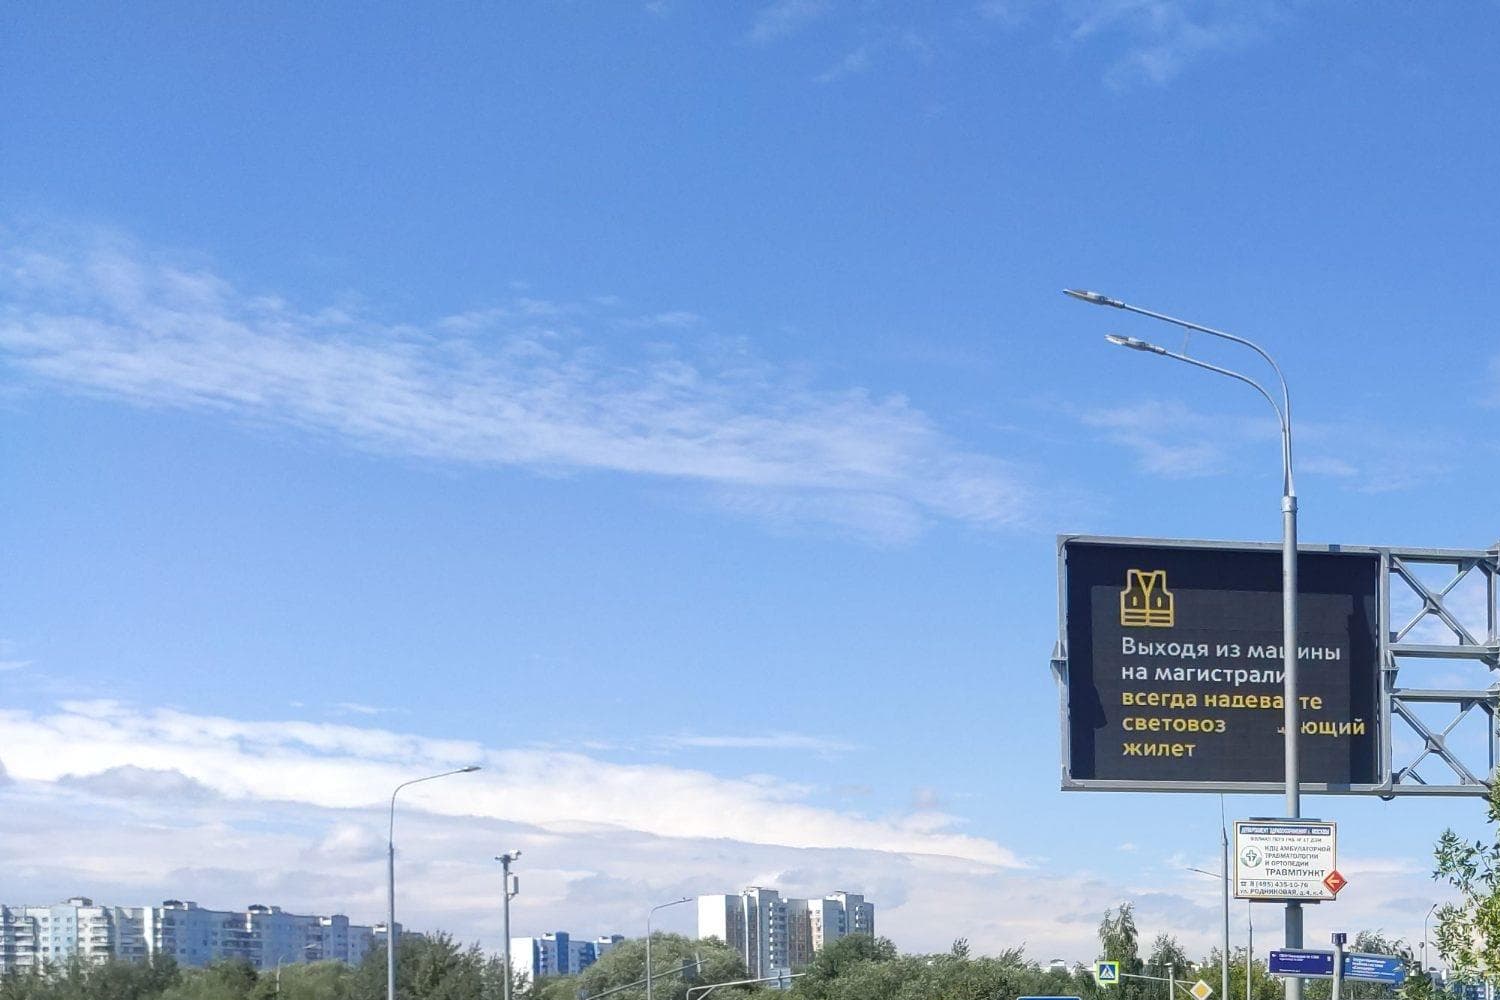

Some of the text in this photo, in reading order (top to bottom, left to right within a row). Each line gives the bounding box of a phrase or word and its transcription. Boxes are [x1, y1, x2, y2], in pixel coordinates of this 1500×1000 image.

[1122, 636, 1208, 659] Выходя
[1216, 644, 1241, 658] из
[1122, 665, 1148, 680] на
[1122, 691, 1323, 710] всегда надевате
[1122, 741, 1196, 758] жилет
[1265, 868, 1326, 877] ТРАВМПУНКТ
